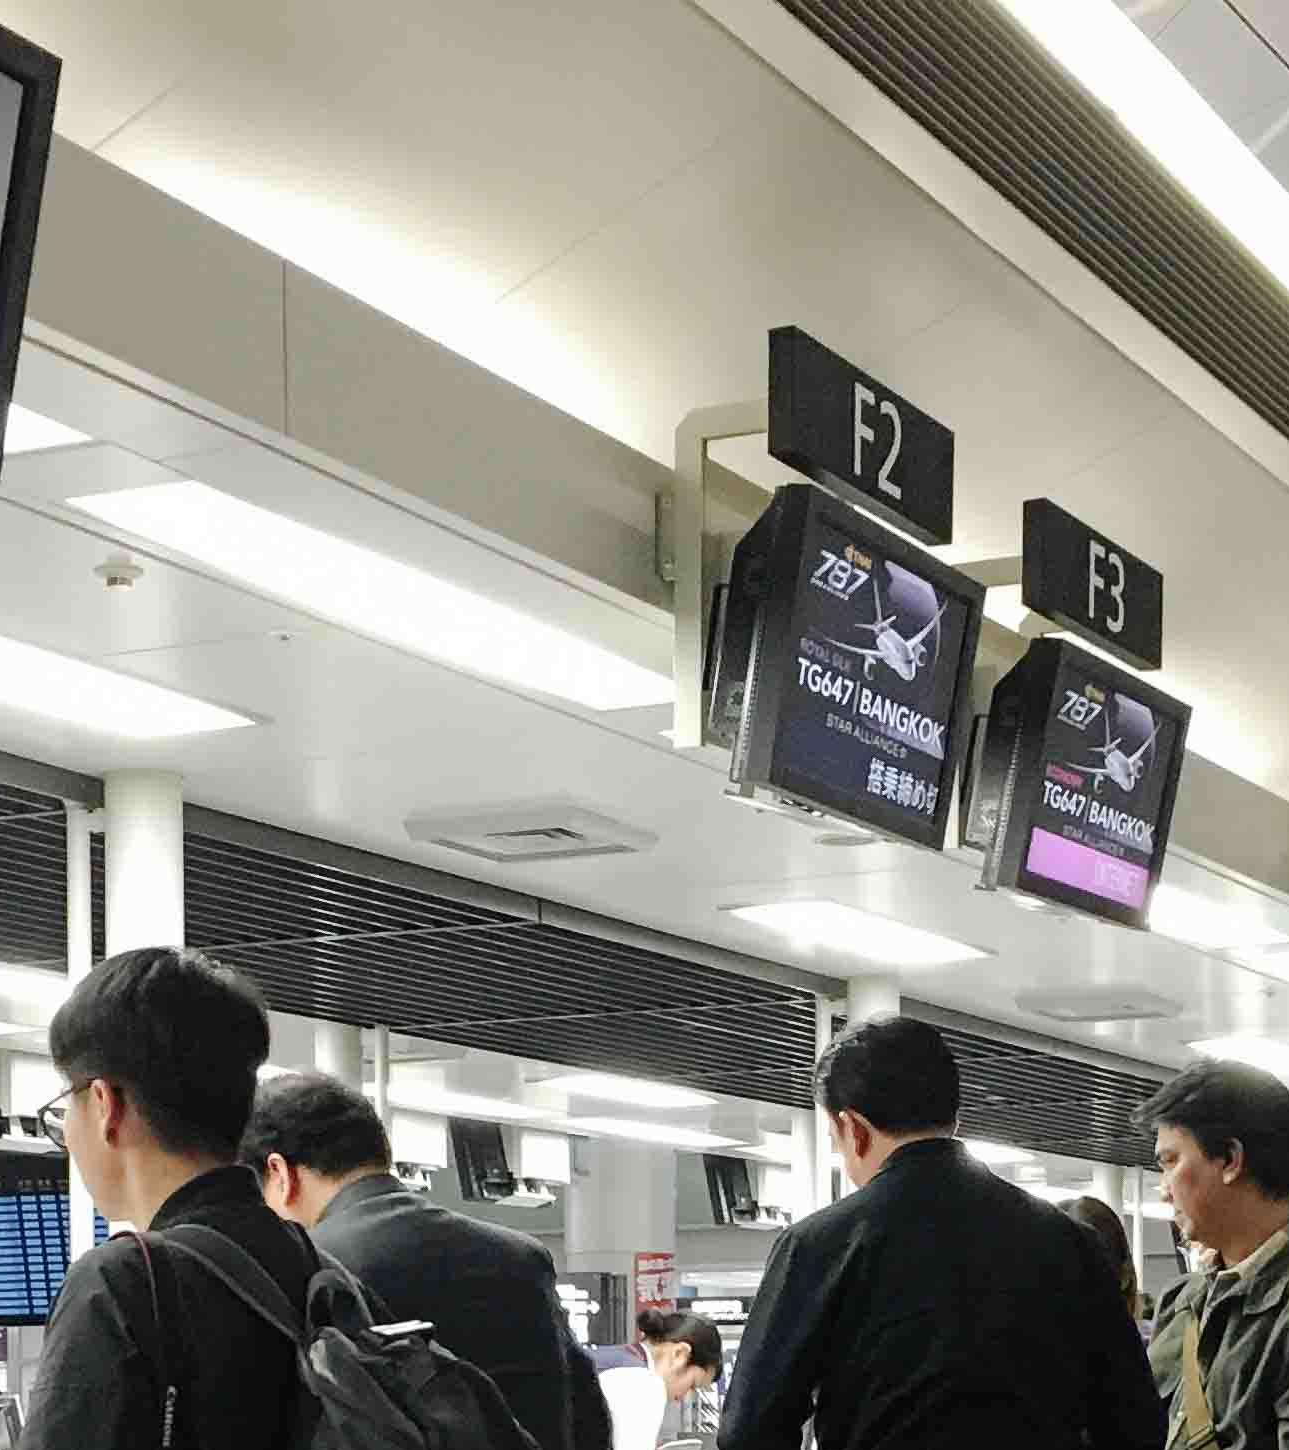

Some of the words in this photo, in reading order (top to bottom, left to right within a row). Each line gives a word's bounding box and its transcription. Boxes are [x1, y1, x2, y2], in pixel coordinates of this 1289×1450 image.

[854, 381, 902, 500] F2
[813, 549, 871, 596] 787
[1088, 540, 1125, 633] F3
[797, 656, 855, 706] TG647
[859, 687, 945, 748] BANGKOK
[826, 712, 853, 737] STAR
[1060, 690, 1102, 725] 787
[1043, 780, 1087, 818] TG647
[1089, 800, 1155, 845] BANGKOK
